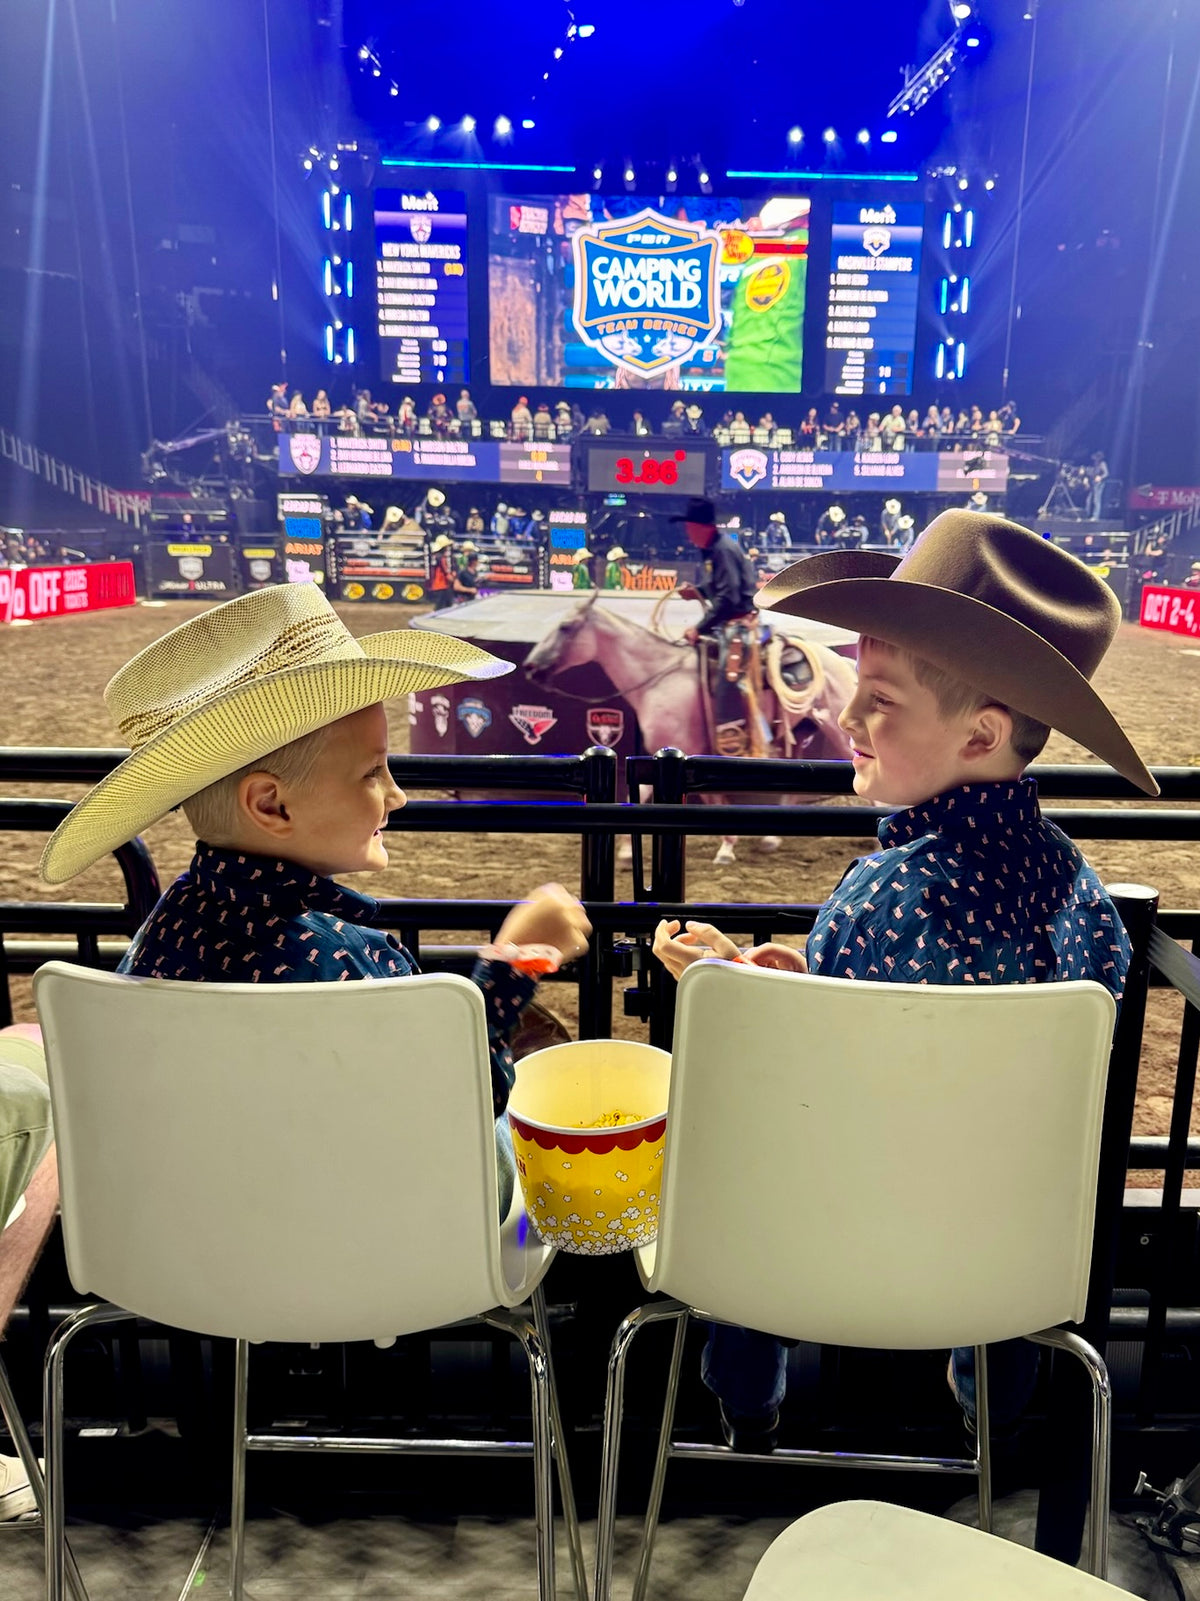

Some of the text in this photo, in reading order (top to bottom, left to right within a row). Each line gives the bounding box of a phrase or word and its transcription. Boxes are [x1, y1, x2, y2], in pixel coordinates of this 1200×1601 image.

[592, 256, 702, 282] CAMPING
[592, 279, 702, 309] WORLD
[596, 319, 698, 337] TEAM SERIES
[615, 458, 678, 485] 3.86
[285, 543, 323, 556] ARIAT
[29, 571, 61, 615] OFF
[1144, 593, 1170, 623] OCT
[514, 709, 552, 720] FREEDOM
